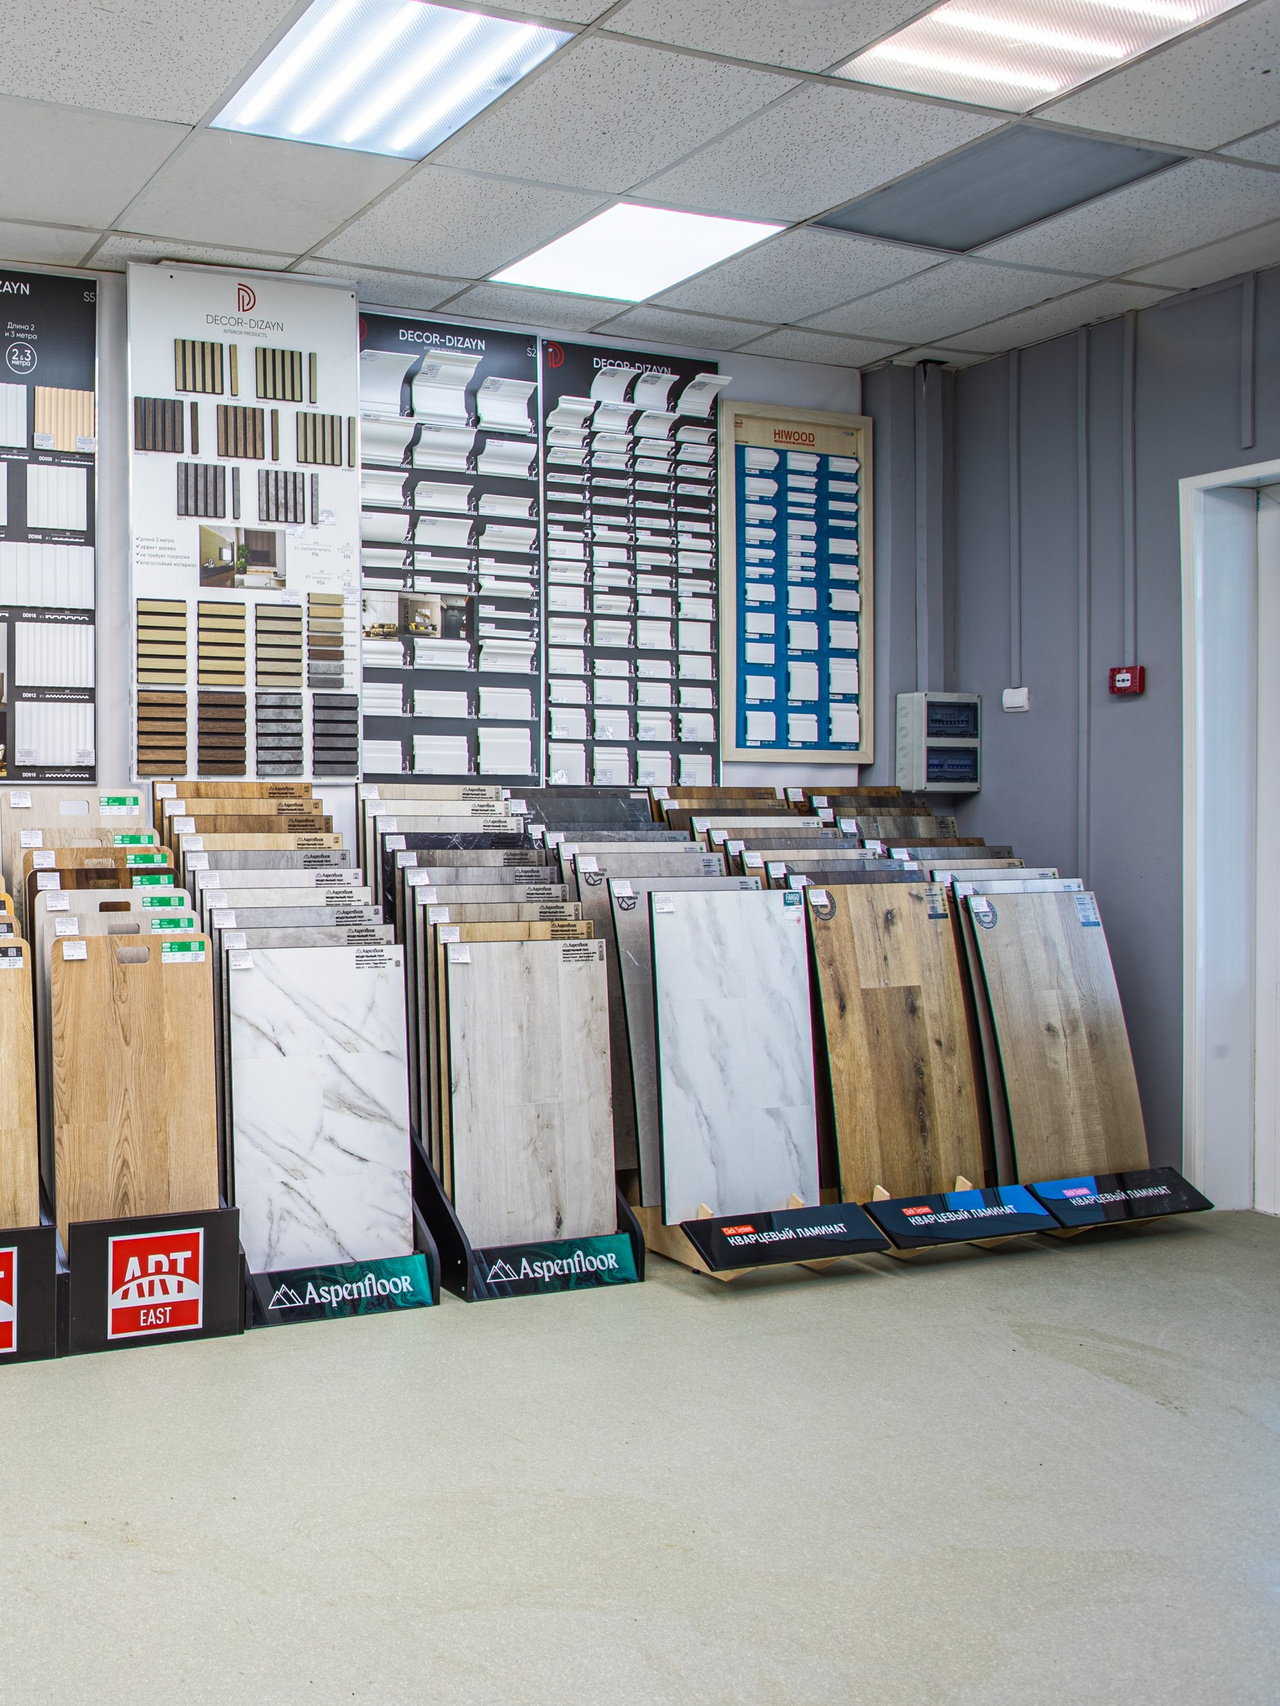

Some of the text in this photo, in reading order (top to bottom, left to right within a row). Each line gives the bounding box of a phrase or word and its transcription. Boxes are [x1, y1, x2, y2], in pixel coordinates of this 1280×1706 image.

[83, 292, 96, 302] S5
[7, 322, 28, 331] Длина
[206, 314, 284, 332] DECOR-DIZAYN
[399, 329, 486, 351] DECOR-DIZAYN
[12, 349, 31, 361] 2 3
[527, 348, 537, 358] S2
[774, 429, 815, 443] HIWOOD
[1069, 1185, 1172, 1206] КВАРЦЕВЫЙ ЛАМИНАТ
[908, 1204, 1018, 1226] КВАРЦЕВЫЙ ЛАМИНАТ
[723, 1226, 754, 1235] Click System
[727, 1223, 848, 1246] КВАРЦЕВЫЙ ЛАМИНАТ
[120, 1250, 192, 1300] ART
[140, 1307, 172, 1327] EAST
